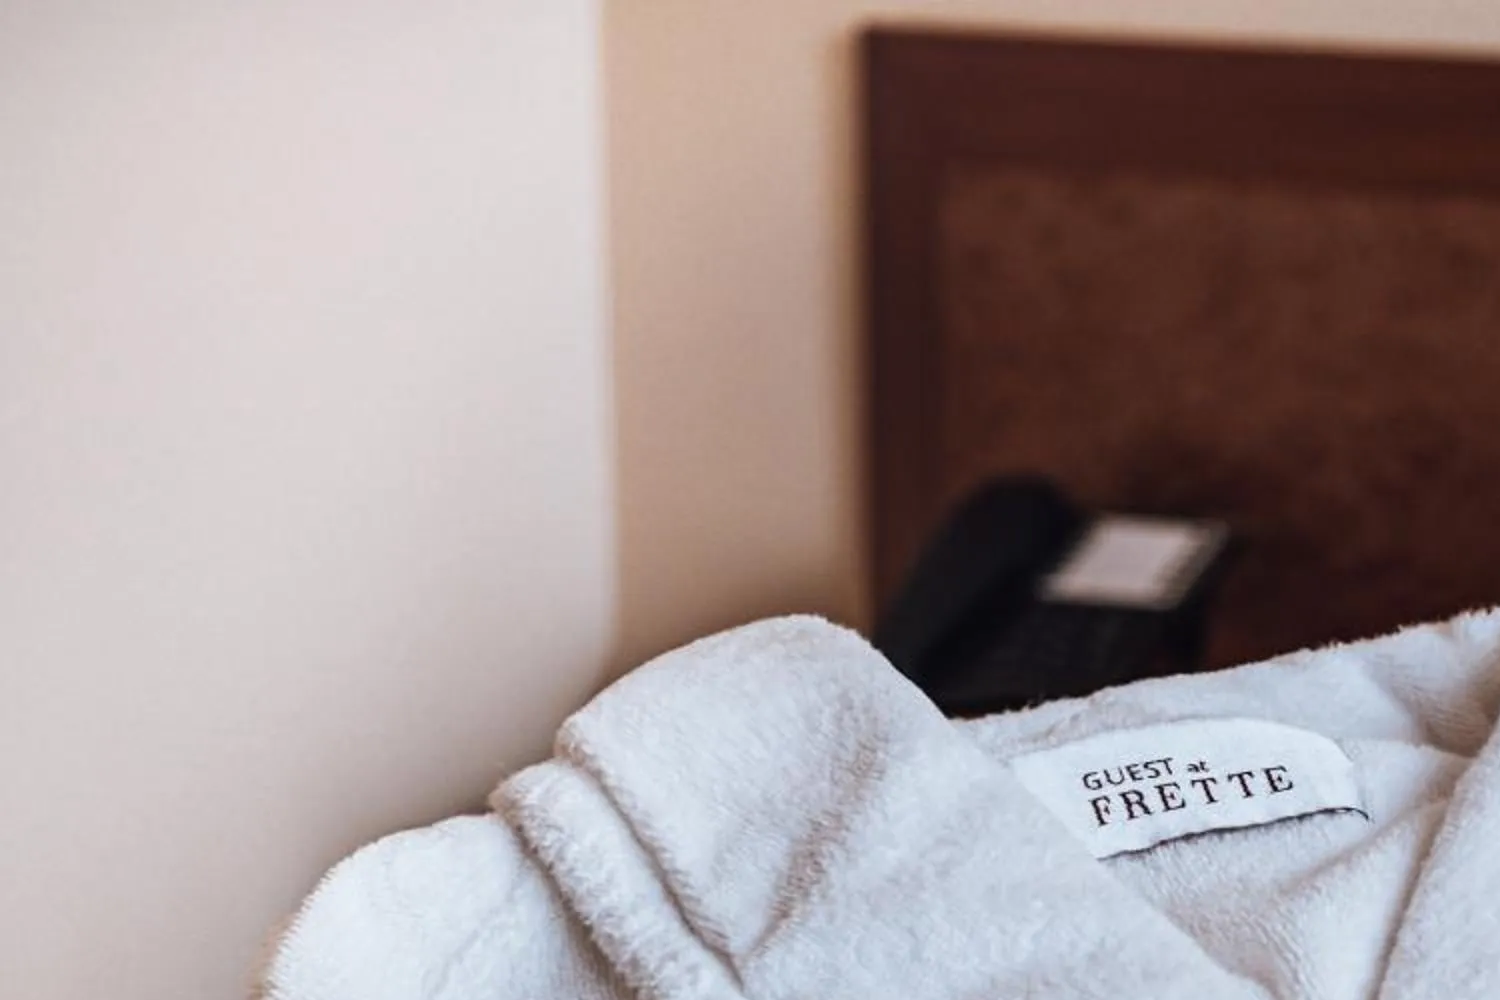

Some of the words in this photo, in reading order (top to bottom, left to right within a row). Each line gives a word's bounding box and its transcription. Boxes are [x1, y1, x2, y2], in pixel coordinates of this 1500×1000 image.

[1082, 757, 1174, 791] GUEST
[1187, 760, 1210, 773] at
[1088, 765, 1294, 827] FRETTE
